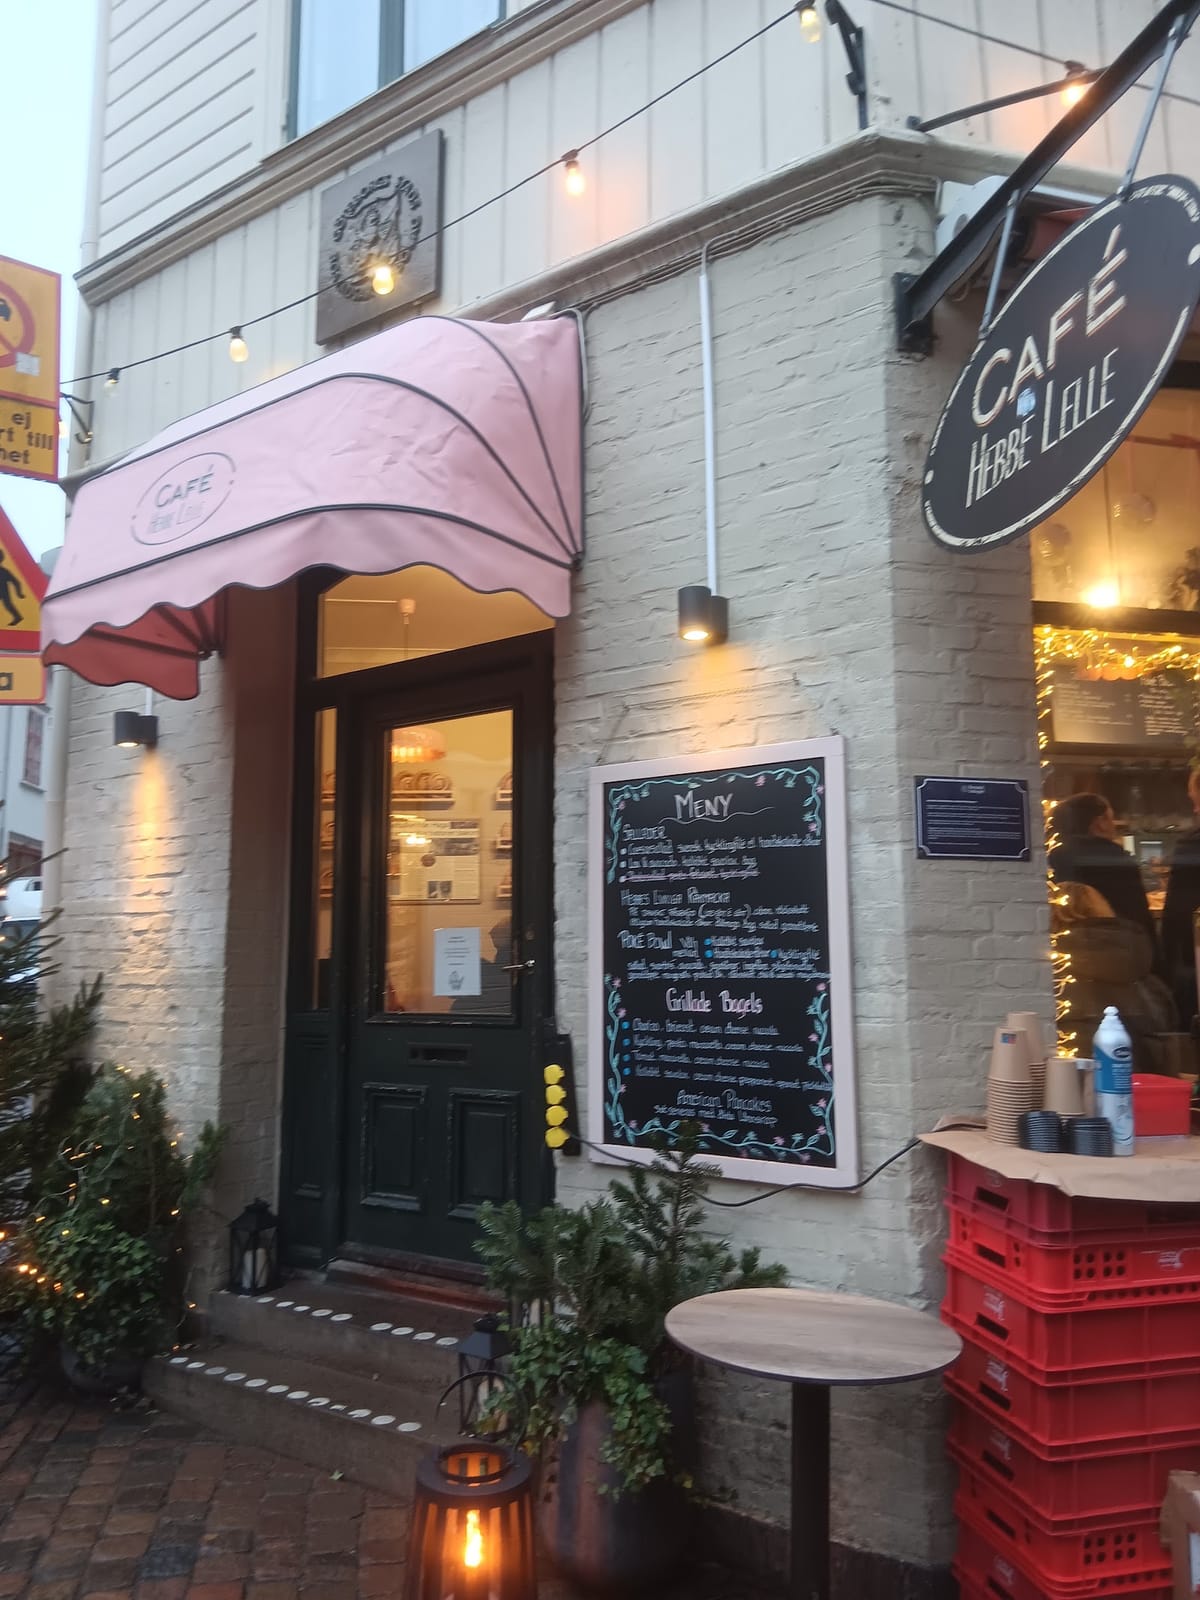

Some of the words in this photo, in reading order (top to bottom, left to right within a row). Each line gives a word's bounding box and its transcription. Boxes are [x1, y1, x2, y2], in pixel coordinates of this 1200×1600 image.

[970, 224, 1129, 428] CAFÉ
[11, 412, 32, 430] ej
[27, 431, 54, 450] till
[965, 413, 1036, 510] HEBBE
[155, 464, 215, 508] CAFÉ
[673, 790, 733, 819] MENY
